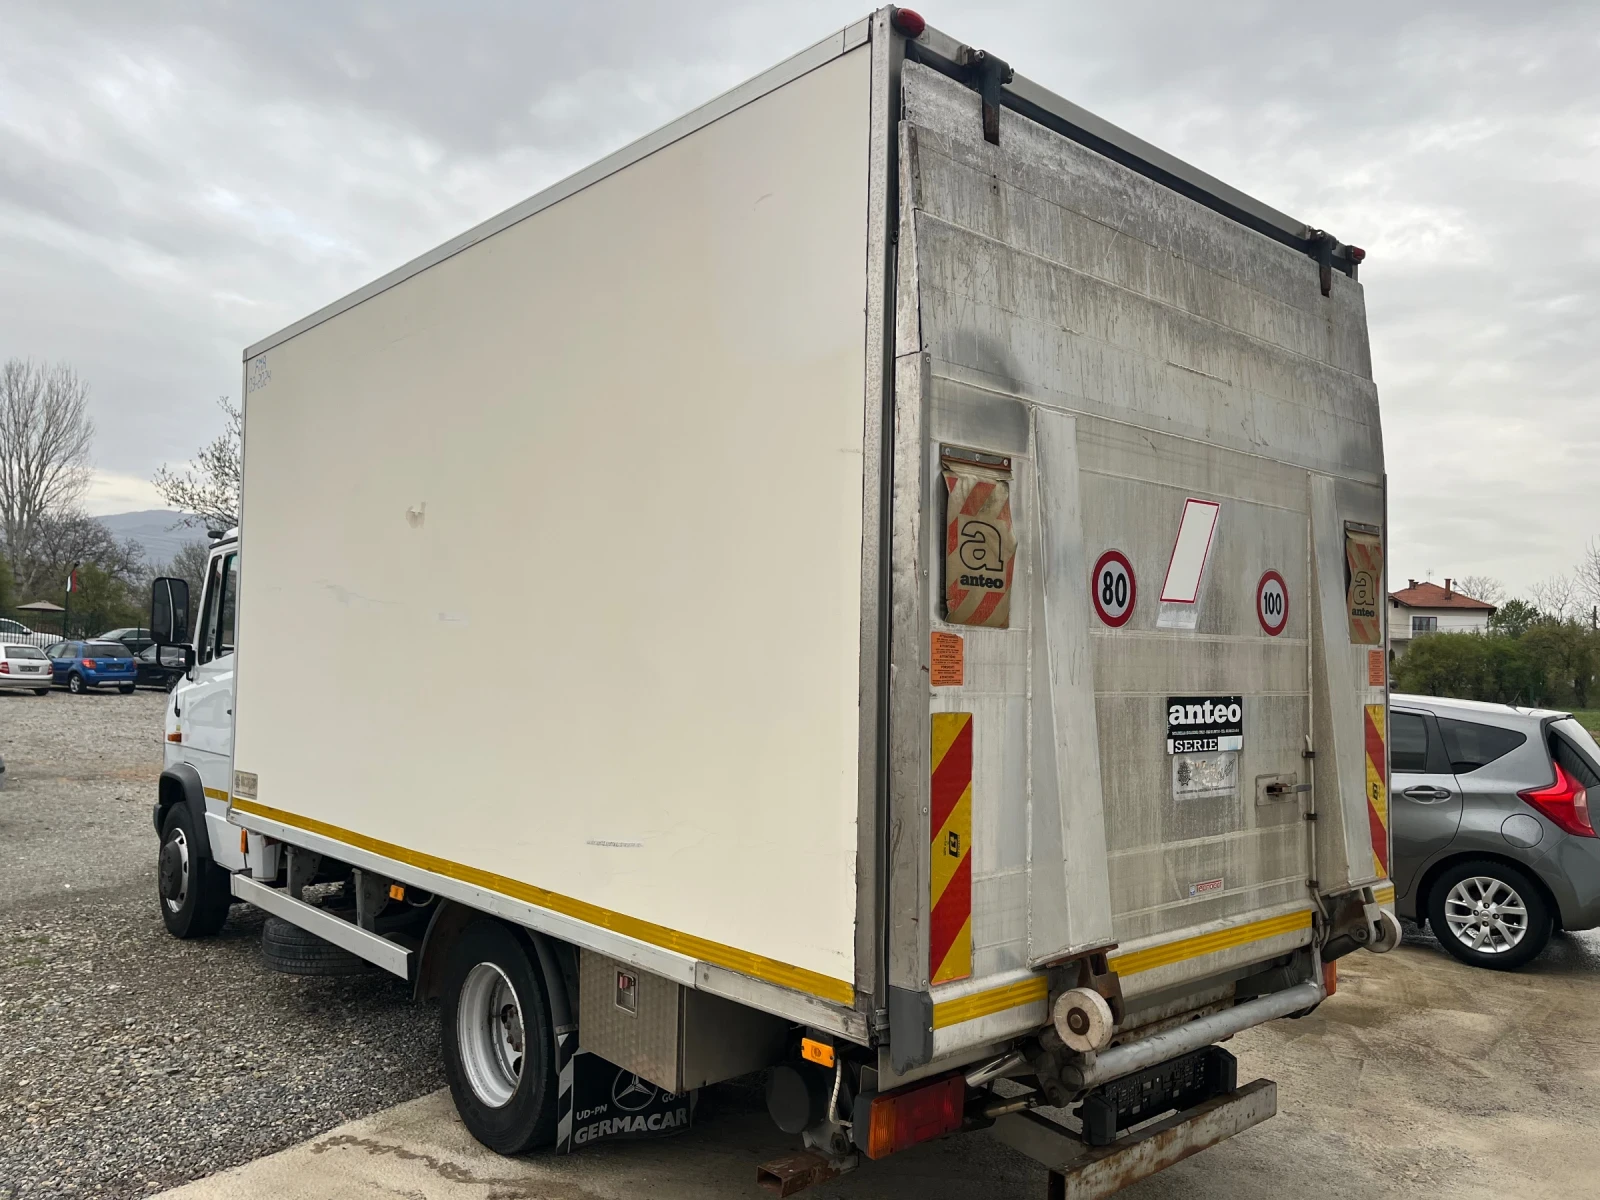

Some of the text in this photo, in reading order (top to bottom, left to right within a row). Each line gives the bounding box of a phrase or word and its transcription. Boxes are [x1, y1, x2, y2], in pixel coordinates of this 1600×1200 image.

[959, 520, 1004, 572] a
[960, 573, 1004, 589] anteo
[1102, 570, 1128, 609] 80
[1263, 591, 1282, 616] 100
[1351, 606, 1375, 618] anteo
[1168, 700, 1242, 726] anteo
[1174, 738, 1218, 753] SERIE
[576, 1104, 608, 1121] UD-PN
[574, 1108, 688, 1144] GERMACAR
